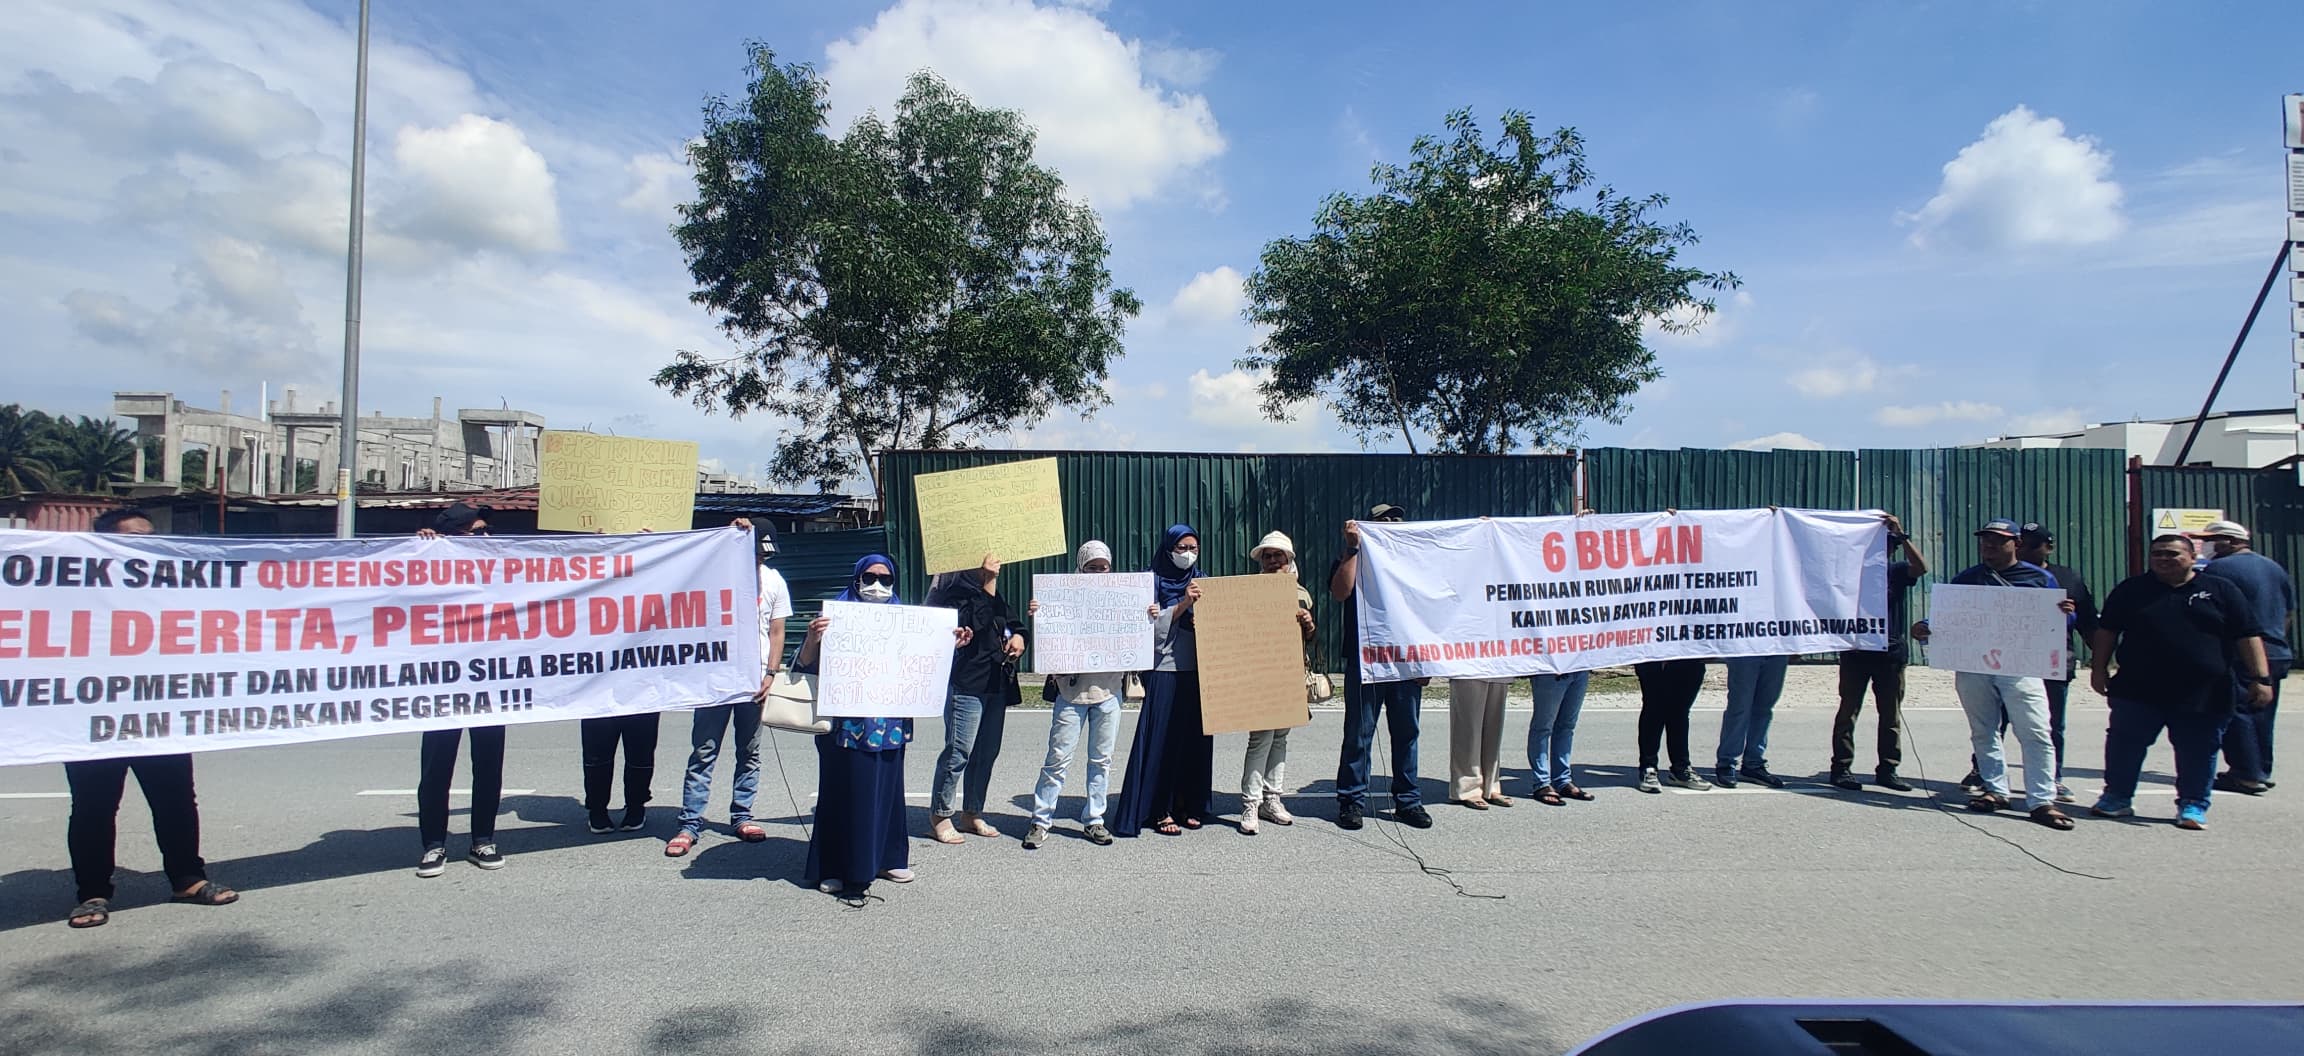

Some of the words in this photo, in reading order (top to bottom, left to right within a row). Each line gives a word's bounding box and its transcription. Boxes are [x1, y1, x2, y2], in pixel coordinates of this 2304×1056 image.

[1542, 531, 1566, 572] 6
[1575, 525, 1703, 570] BULAN
[2, 555, 113, 587] OJEK
[123, 560, 248, 588] SAKIT
[258, 558, 498, 591] QUEENSBURY
[503, 555, 606, 583] PHASE
[614, 555, 633, 578] II
[1486, 582, 1581, 601] PEMBINAAN
[1585, 575, 1641, 598] RUMAH
[1644, 573, 1679, 592] KAMI
[1683, 570, 1758, 589] TERHENTI
[0, 610, 91, 658] ELI
[110, 607, 357, 656] DERITA,
[373, 598, 576, 647] PEMAJU
[589, 590, 706, 636] DIAM
[720, 589, 733, 625] !
[1511, 610, 1551, 628] KAMI
[1556, 606, 1610, 626] MASIH
[1613, 598, 1656, 620] BAYAR
[1659, 597, 1739, 616] PINJAMAN
[1362, 645, 1441, 664] UMLAND
[1444, 641, 1476, 661] DAN
[1479, 639, 1505, 658] KIA
[1511, 638, 1543, 656] ACE
[1547, 627, 1653, 654] DEVELOPMENT
[1655, 624, 1692, 642] SILA
[0, 671, 238, 707] VELOPMENT
[247, 667, 318, 695] DAN
[327, 660, 460, 692] UMLAND
[468, 657, 534, 682] SILA
[541, 652, 603, 677] BERI
[610, 641, 728, 671] JAWAPAN
[90, 711, 170, 742] DAN
[181, 700, 362, 736] TINDAKAN
[370, 691, 493, 721] SEGERA
[500, 688, 532, 711] !!!
